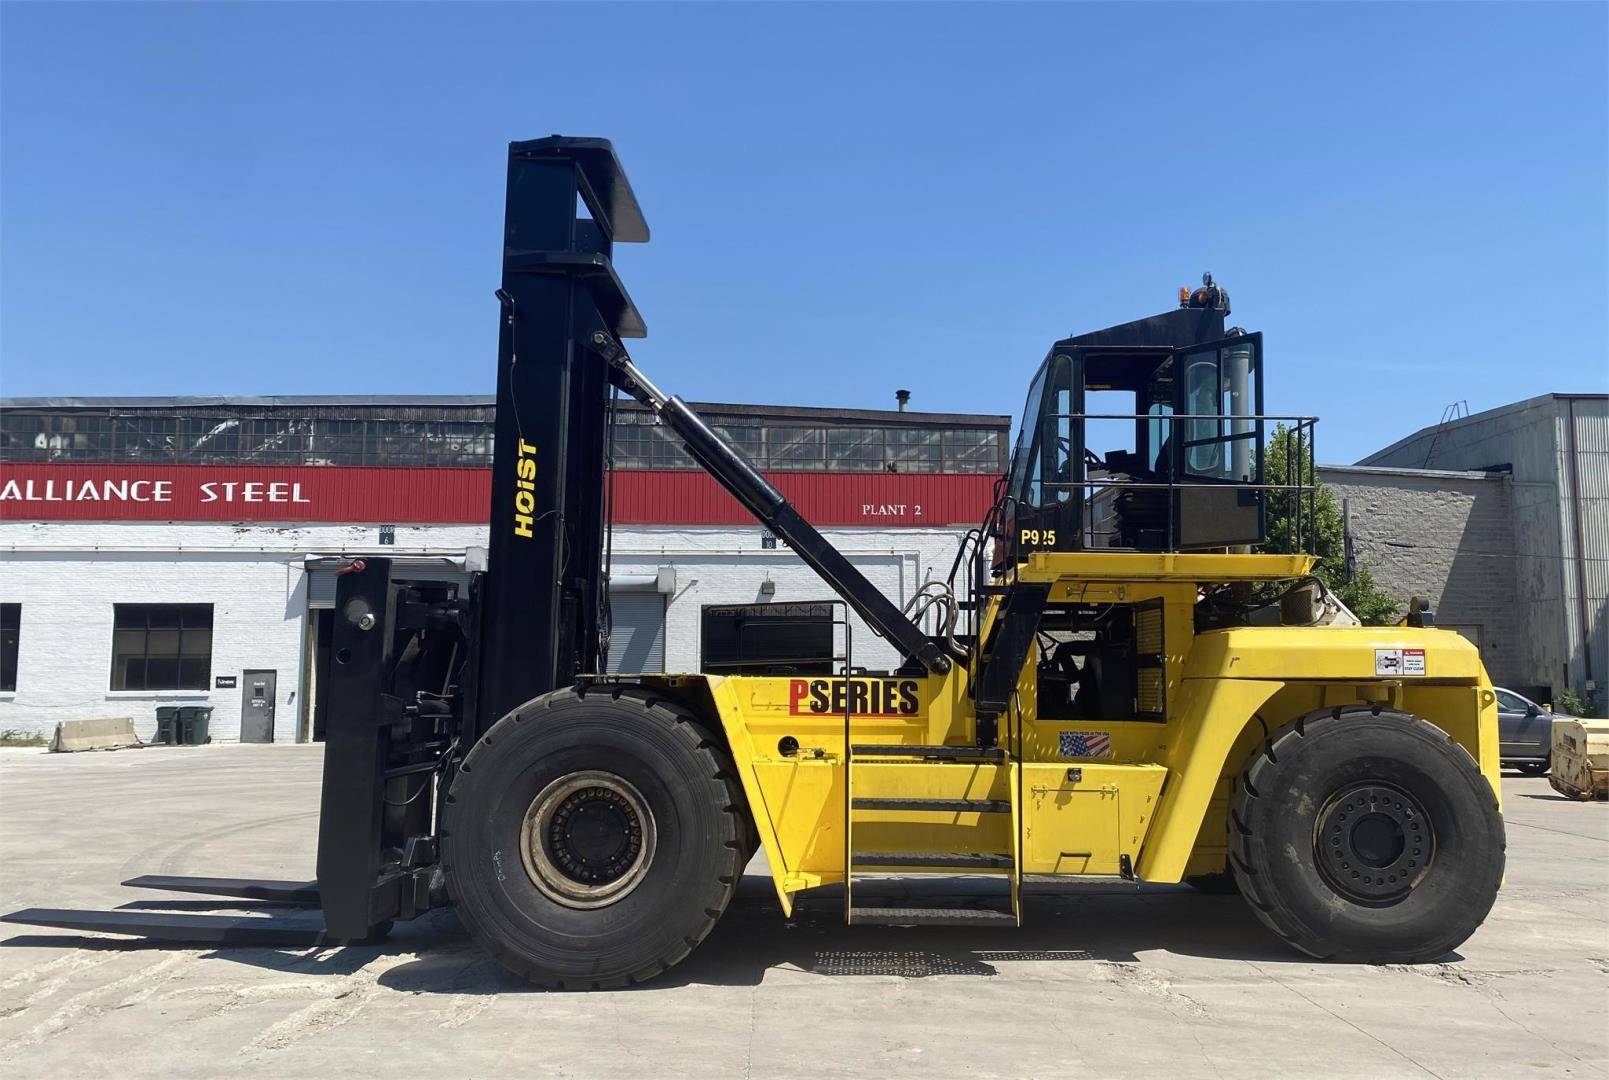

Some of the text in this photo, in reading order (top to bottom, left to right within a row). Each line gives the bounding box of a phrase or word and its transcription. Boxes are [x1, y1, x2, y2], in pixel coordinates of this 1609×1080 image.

[0, 479, 311, 503] ALLIANCE STEEL
[514, 438, 537, 538] HOIST
[862, 504, 922, 516] PLANT 2
